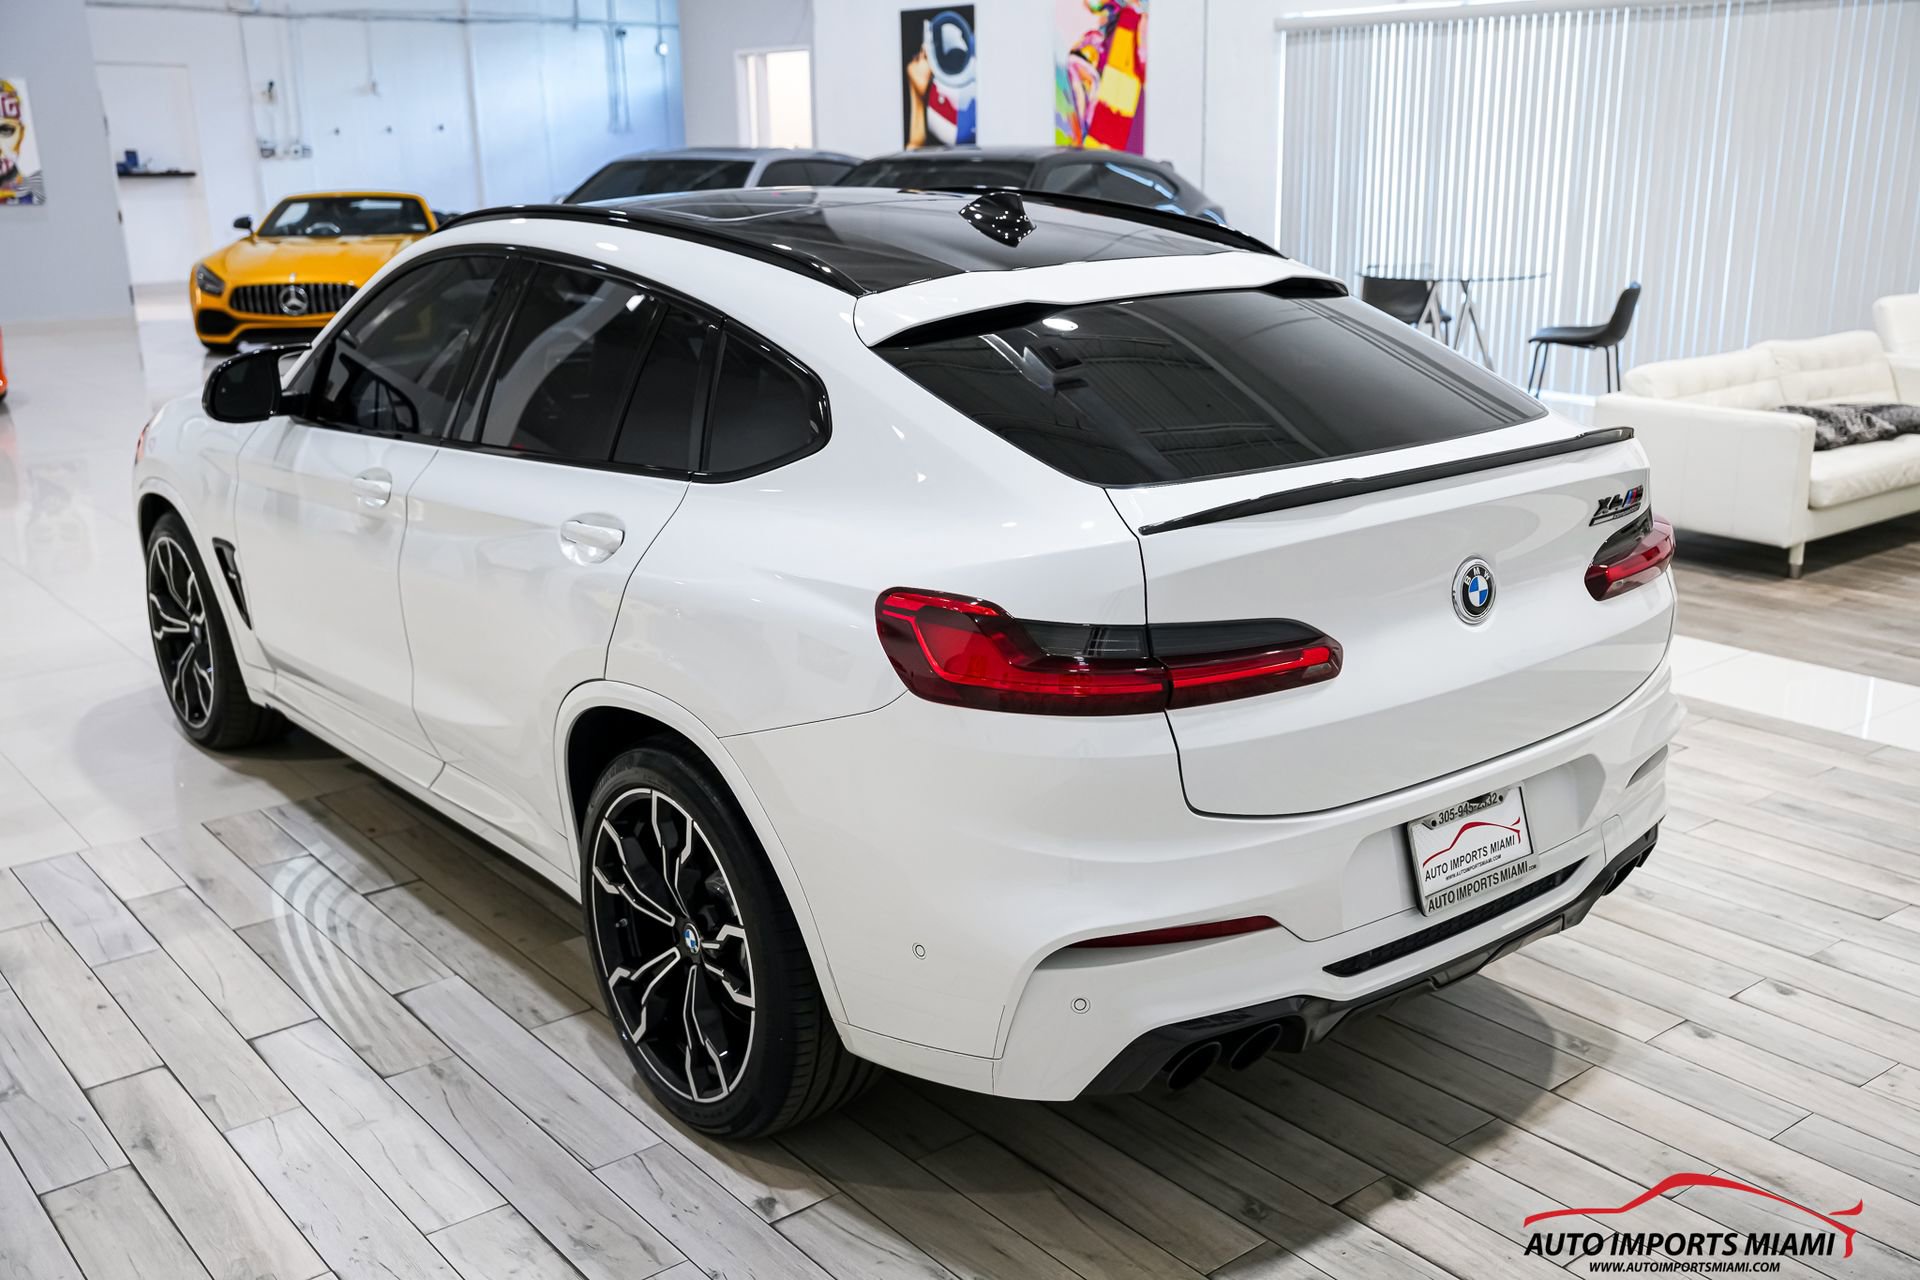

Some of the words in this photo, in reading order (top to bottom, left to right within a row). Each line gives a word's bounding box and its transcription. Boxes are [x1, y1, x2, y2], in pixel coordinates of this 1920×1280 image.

[1464, 567, 1490, 586] BMW
[1425, 862, 1448, 882] AUTO
[1450, 846, 1488, 871] IMPORTS
[1490, 835, 1515, 854] MIAMI
[1428, 889, 1455, 912] AUTO
[1456, 872, 1499, 901] IMPORTS
